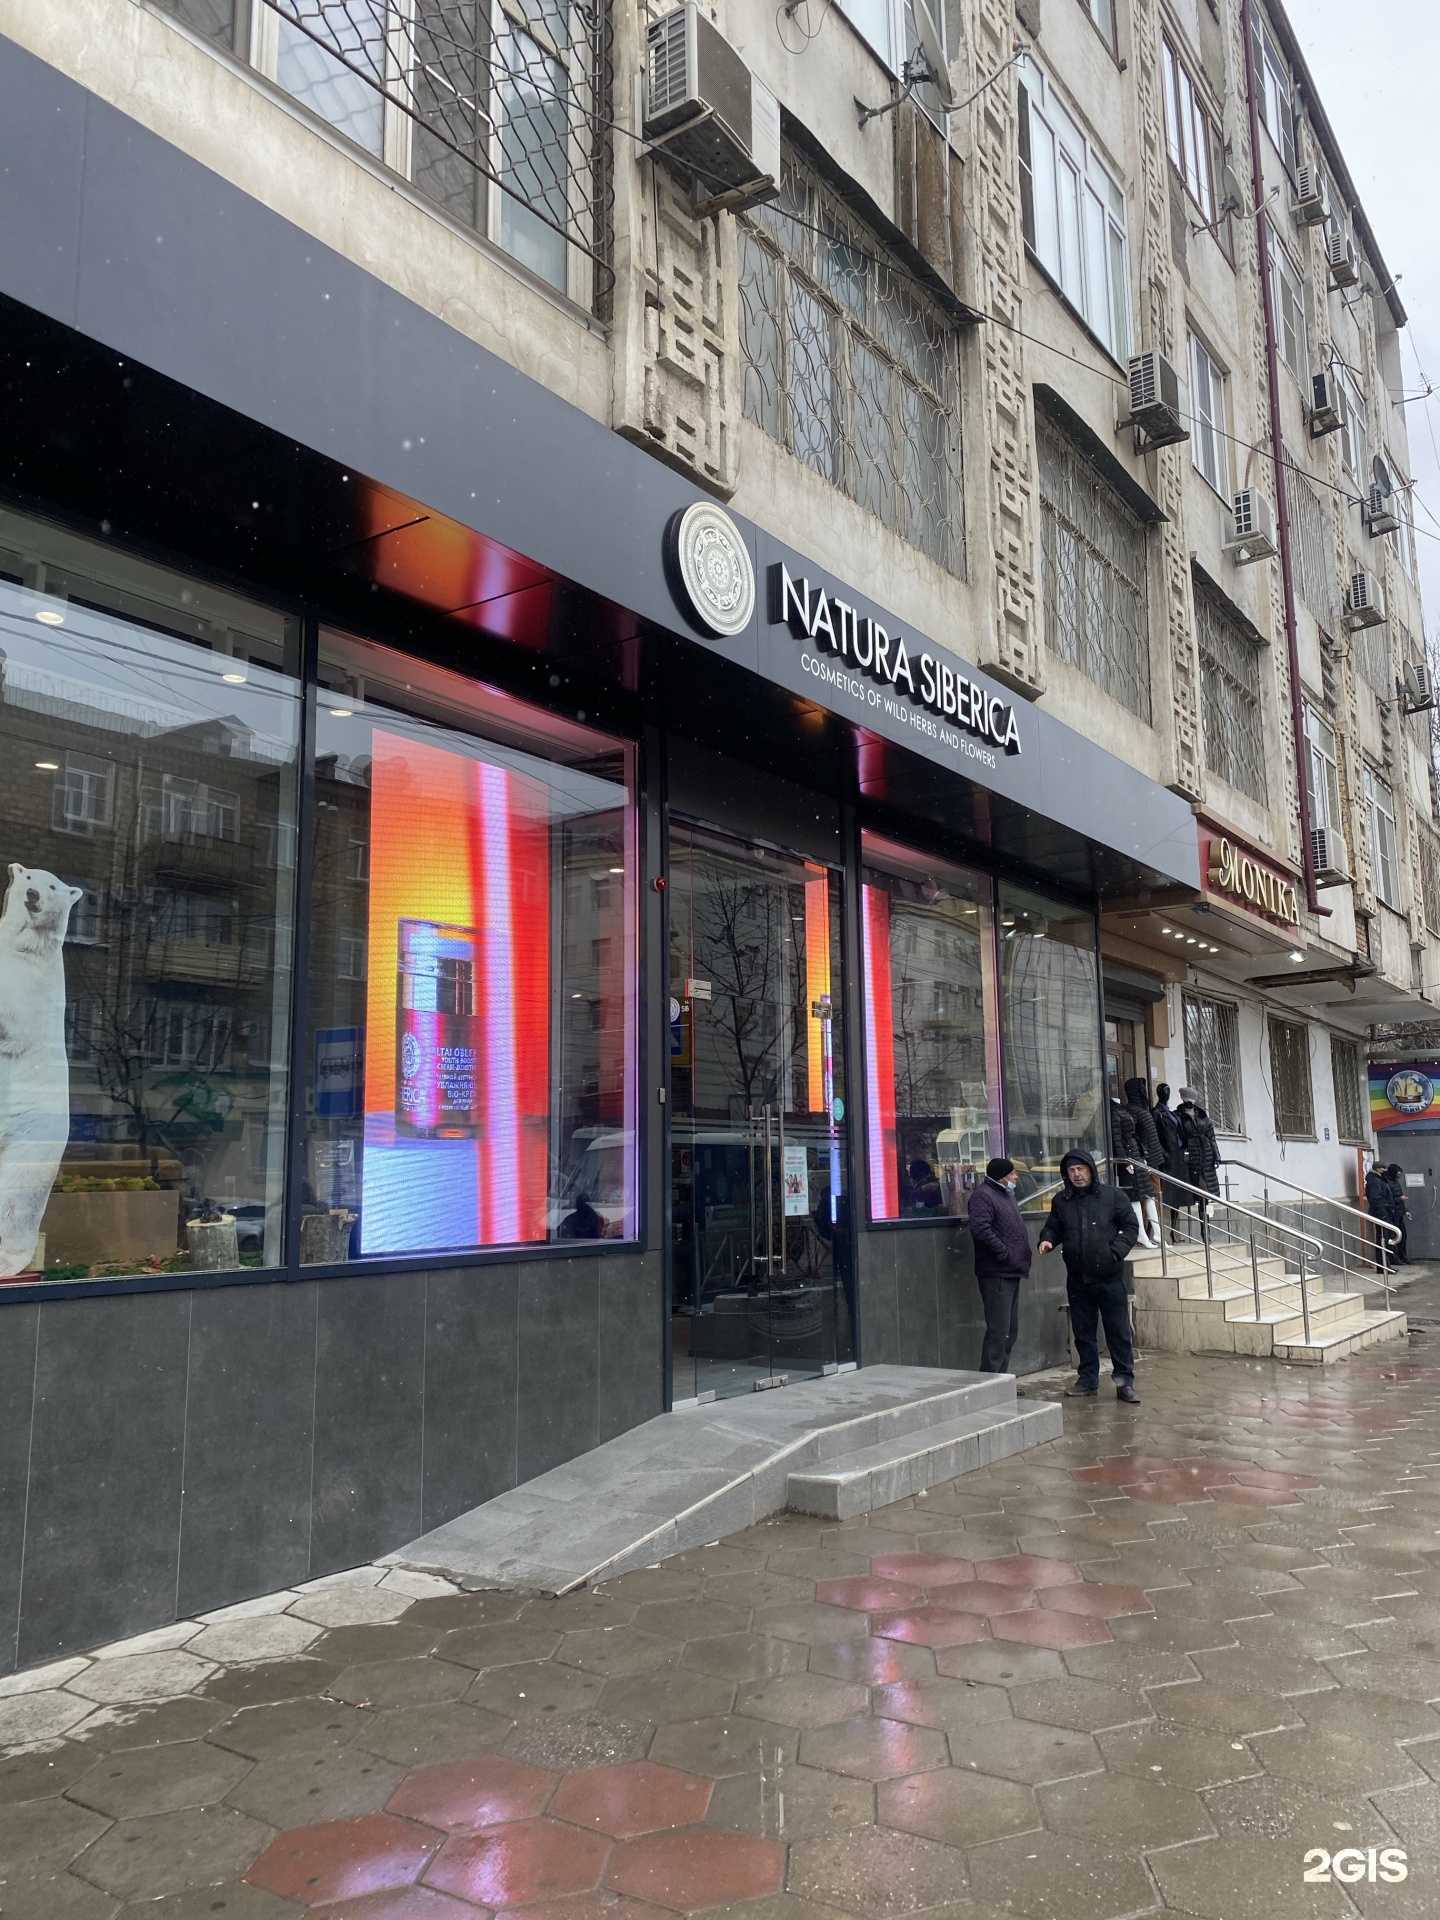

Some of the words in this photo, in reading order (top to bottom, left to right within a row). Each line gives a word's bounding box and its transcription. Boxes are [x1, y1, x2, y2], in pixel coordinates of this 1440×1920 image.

[781, 561, 914, 694] NATURA
[920, 652, 1022, 754] SIBERICA
[801, 653, 866, 701] COSMETICS
[868, 689, 882, 709] OF
[884, 697, 907, 722] WILD
[910, 715, 937, 738] HERBS
[940, 730, 959, 750] AND
[961, 739, 996, 769] FLOWERS
[1219, 837, 1300, 926] MONIKA
